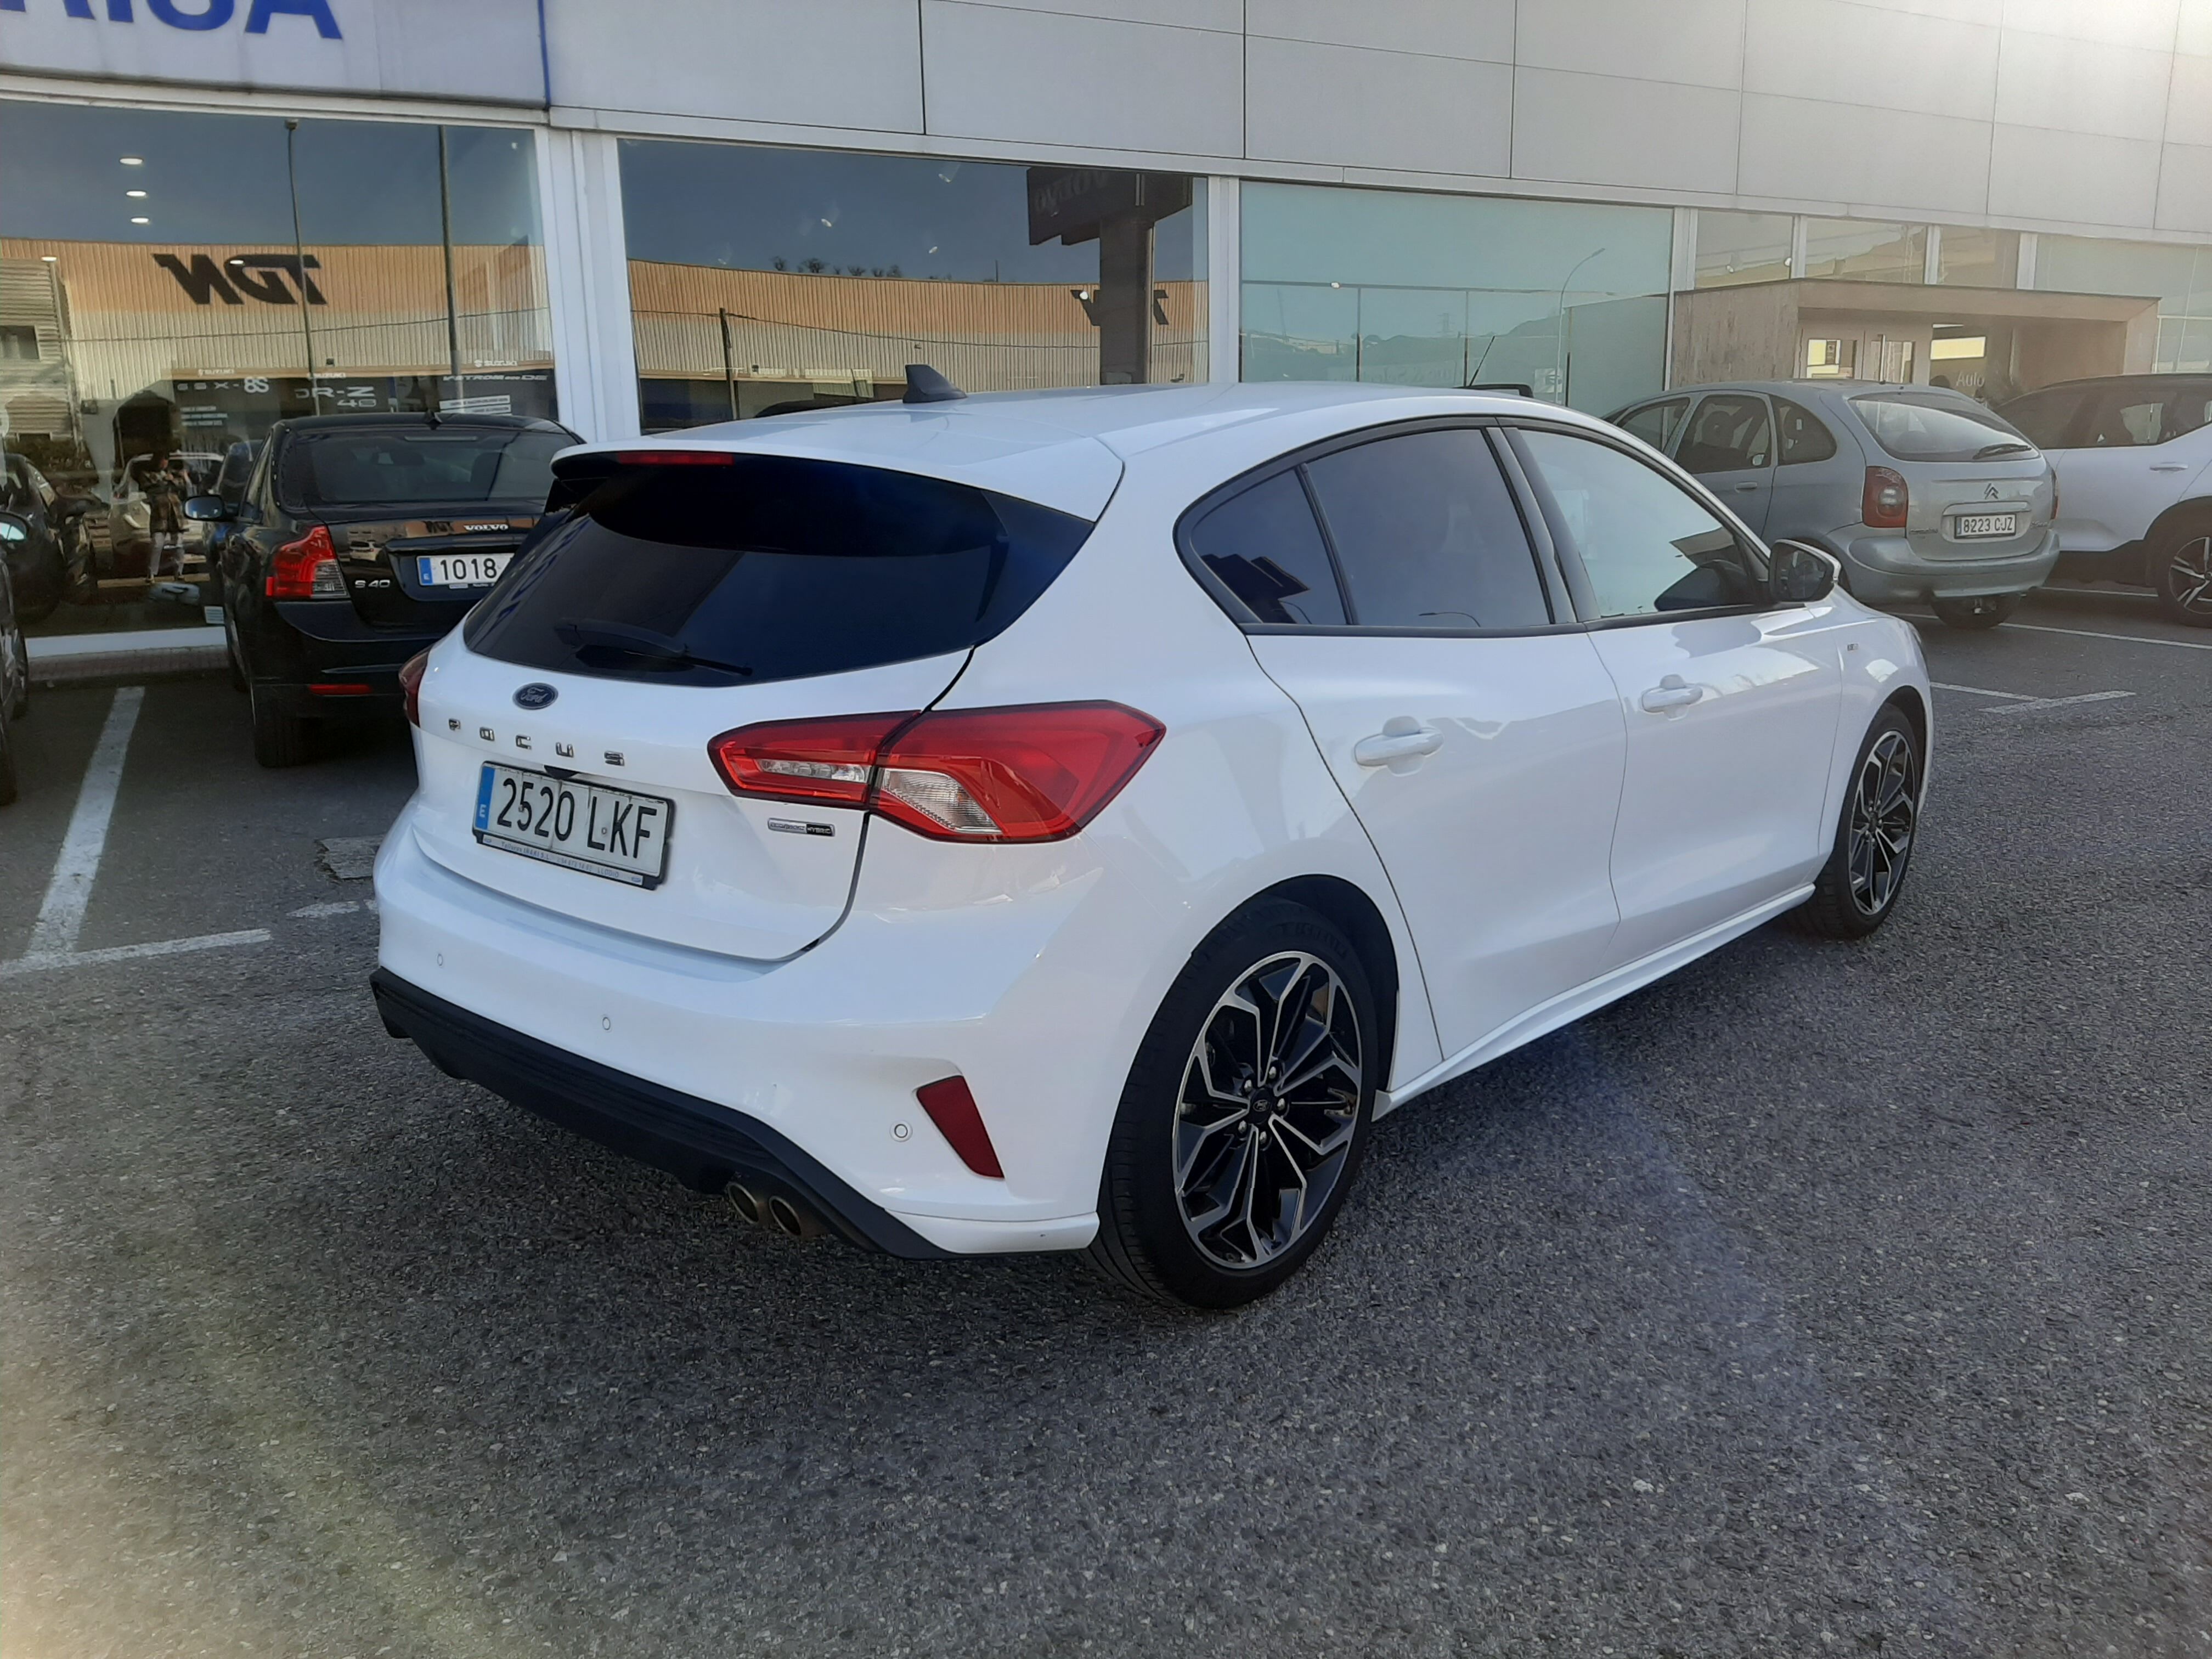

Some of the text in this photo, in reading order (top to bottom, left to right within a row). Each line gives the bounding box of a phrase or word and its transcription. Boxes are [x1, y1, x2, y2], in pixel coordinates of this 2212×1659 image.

[1963, 518, 1990, 533] 8223
[1994, 517, 2013, 532] CJZ
[440, 558, 497, 581] 1018
[448, 718, 625, 766] FOCUS
[496, 778, 657, 859] 2520 LKF
